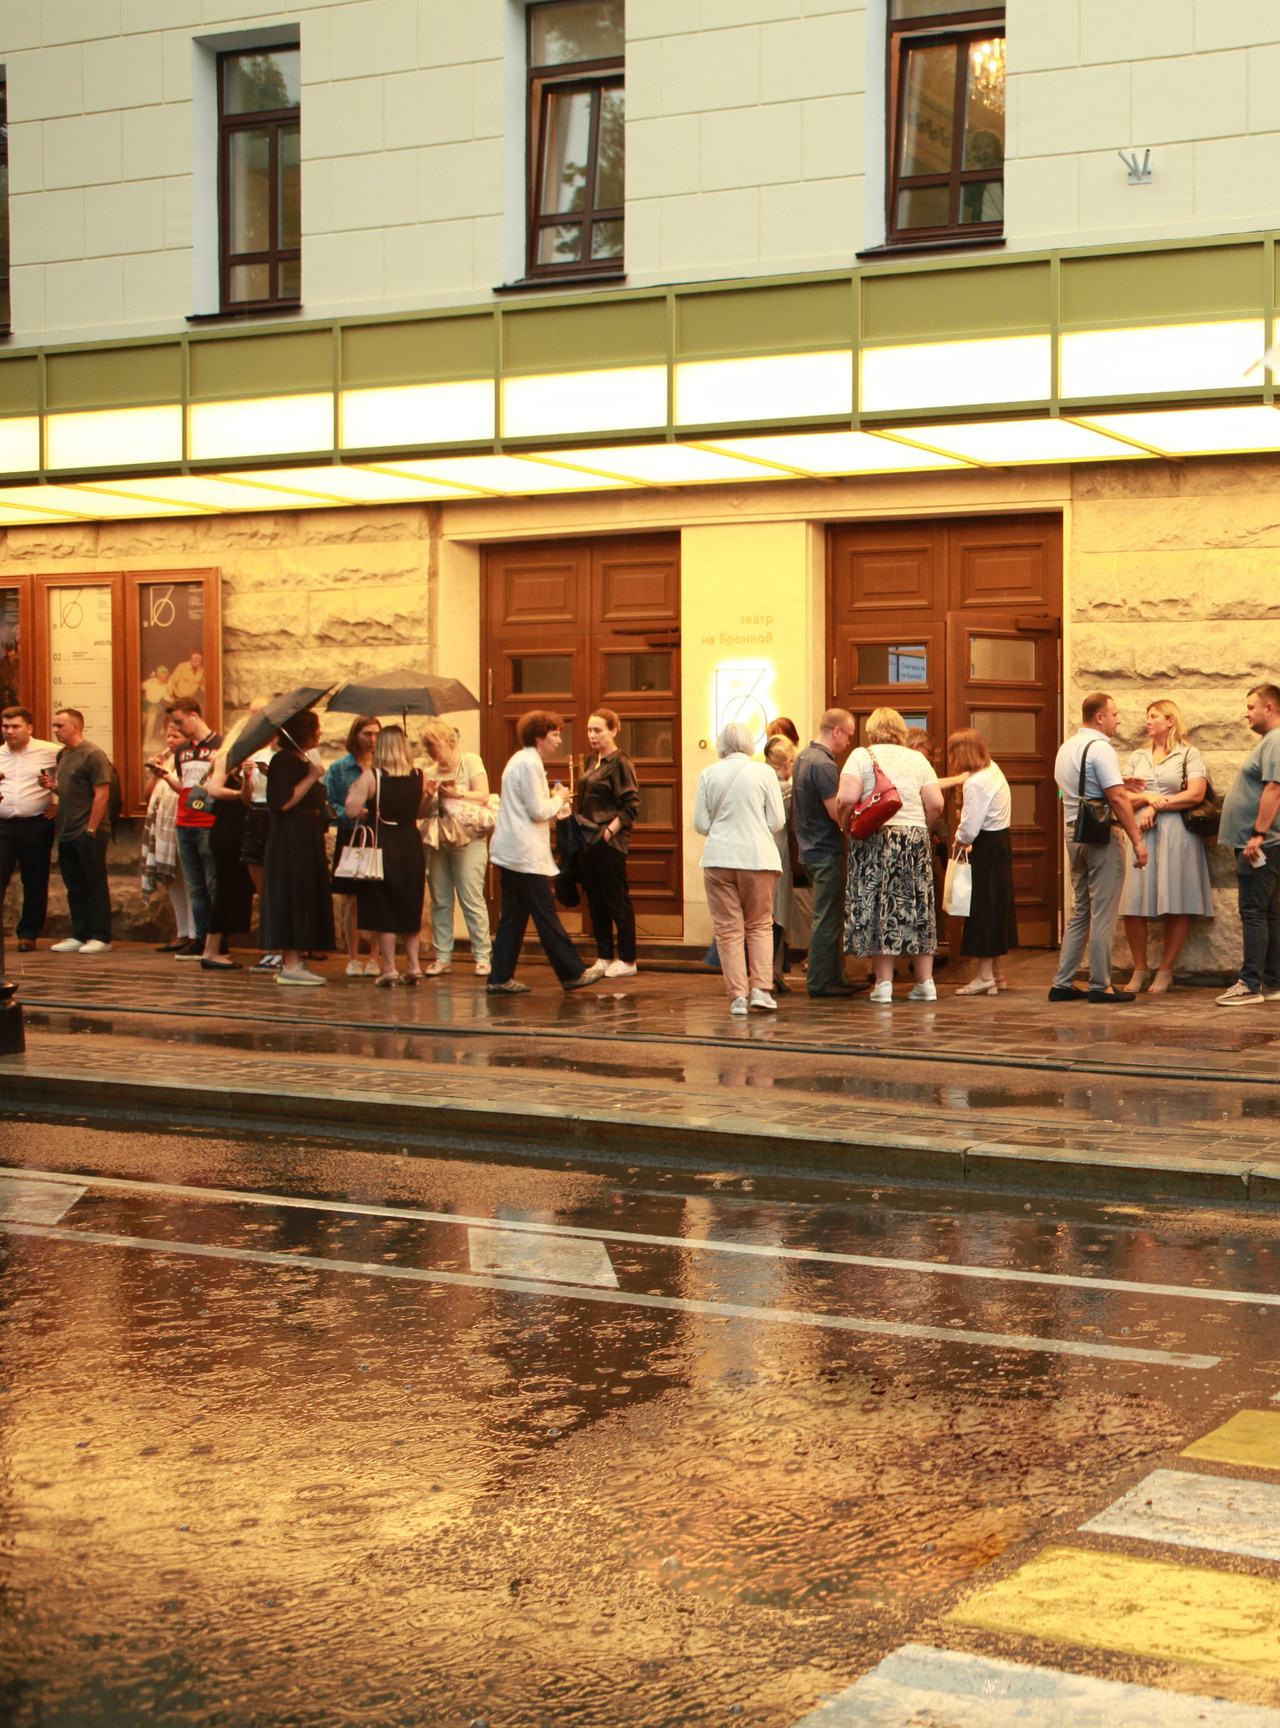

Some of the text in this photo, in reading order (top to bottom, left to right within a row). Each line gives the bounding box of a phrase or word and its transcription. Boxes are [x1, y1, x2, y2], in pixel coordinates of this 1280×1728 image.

[739, 615, 774, 627] театр
[701, 635, 716, 646] на
[53, 653, 62, 661] 02
[53, 677, 62, 685] 03
[53, 700, 62, 708] 04
